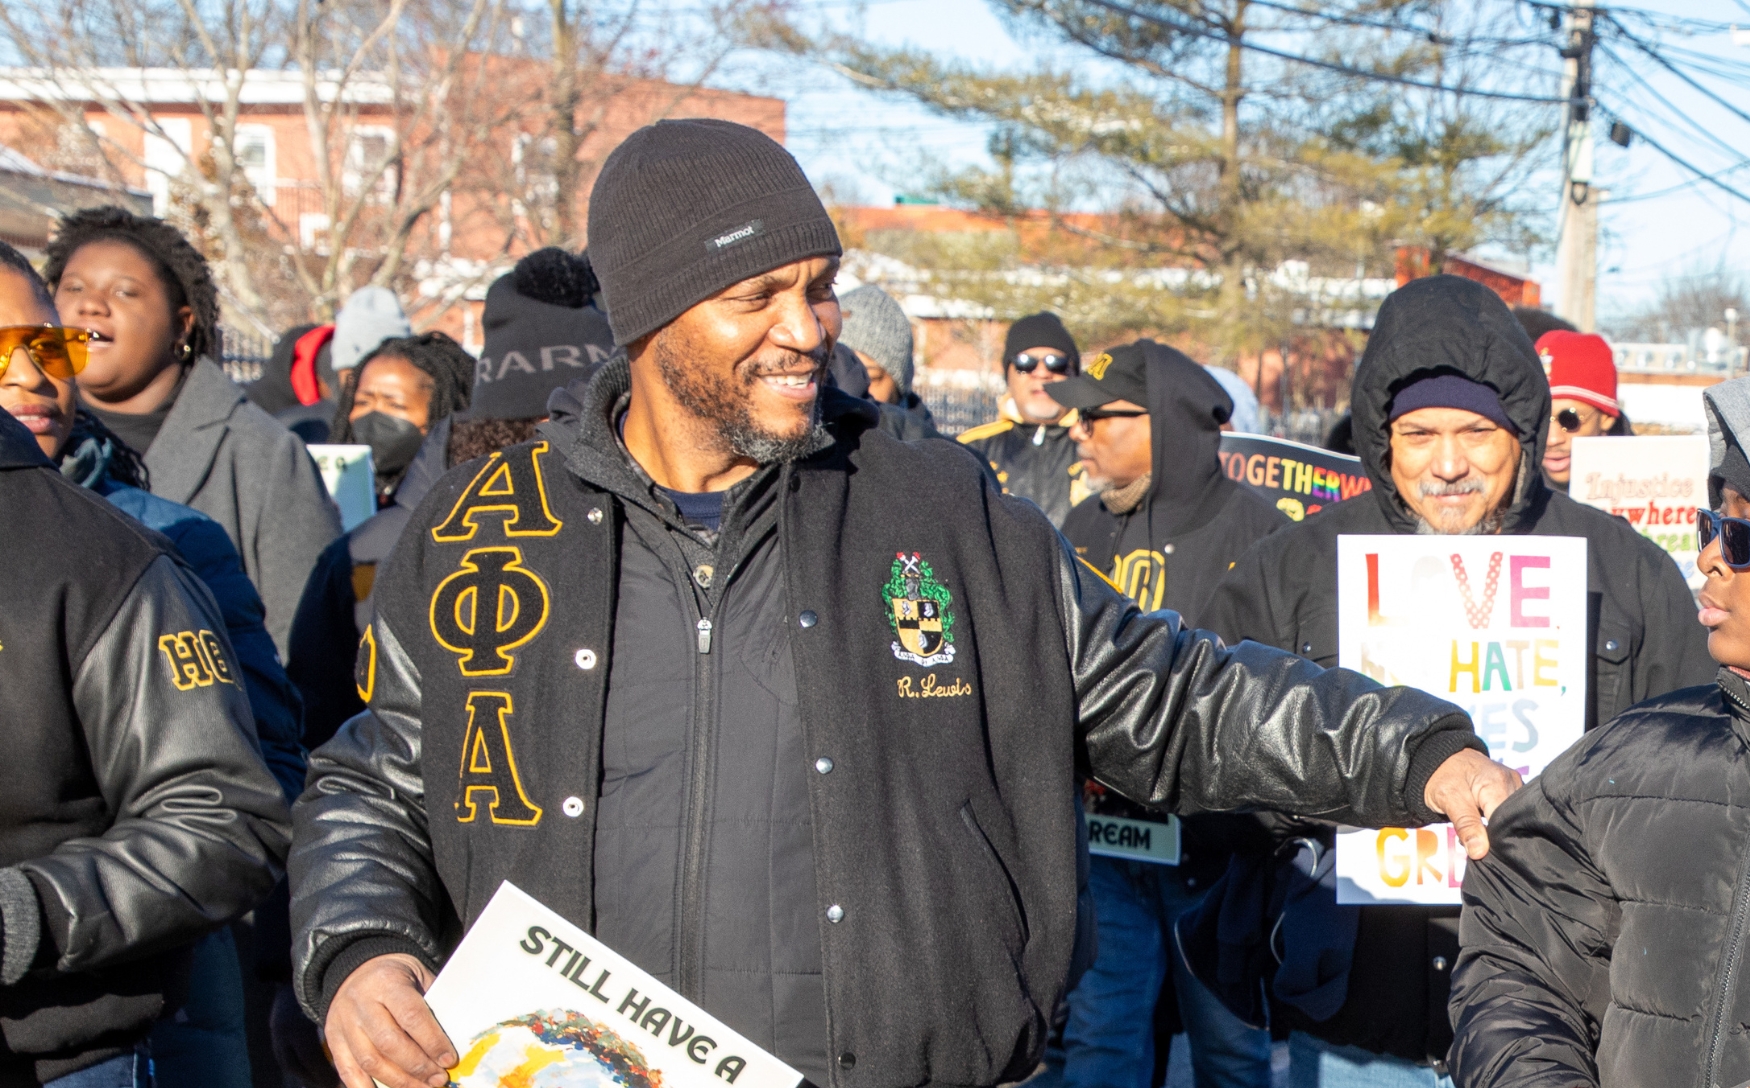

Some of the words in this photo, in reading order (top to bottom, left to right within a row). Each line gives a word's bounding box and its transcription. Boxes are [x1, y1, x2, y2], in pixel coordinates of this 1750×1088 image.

[714, 226, 755, 248] Marmot
[1585, 471, 1694, 502] Injustice
[1448, 638, 1568, 698] HATE,
[1088, 820, 1152, 851] REAM
[1376, 826, 1468, 888] GRE
[519, 924, 612, 1005] STILL
[617, 986, 718, 1065] HAVE
[713, 1053, 748, 1086] A
